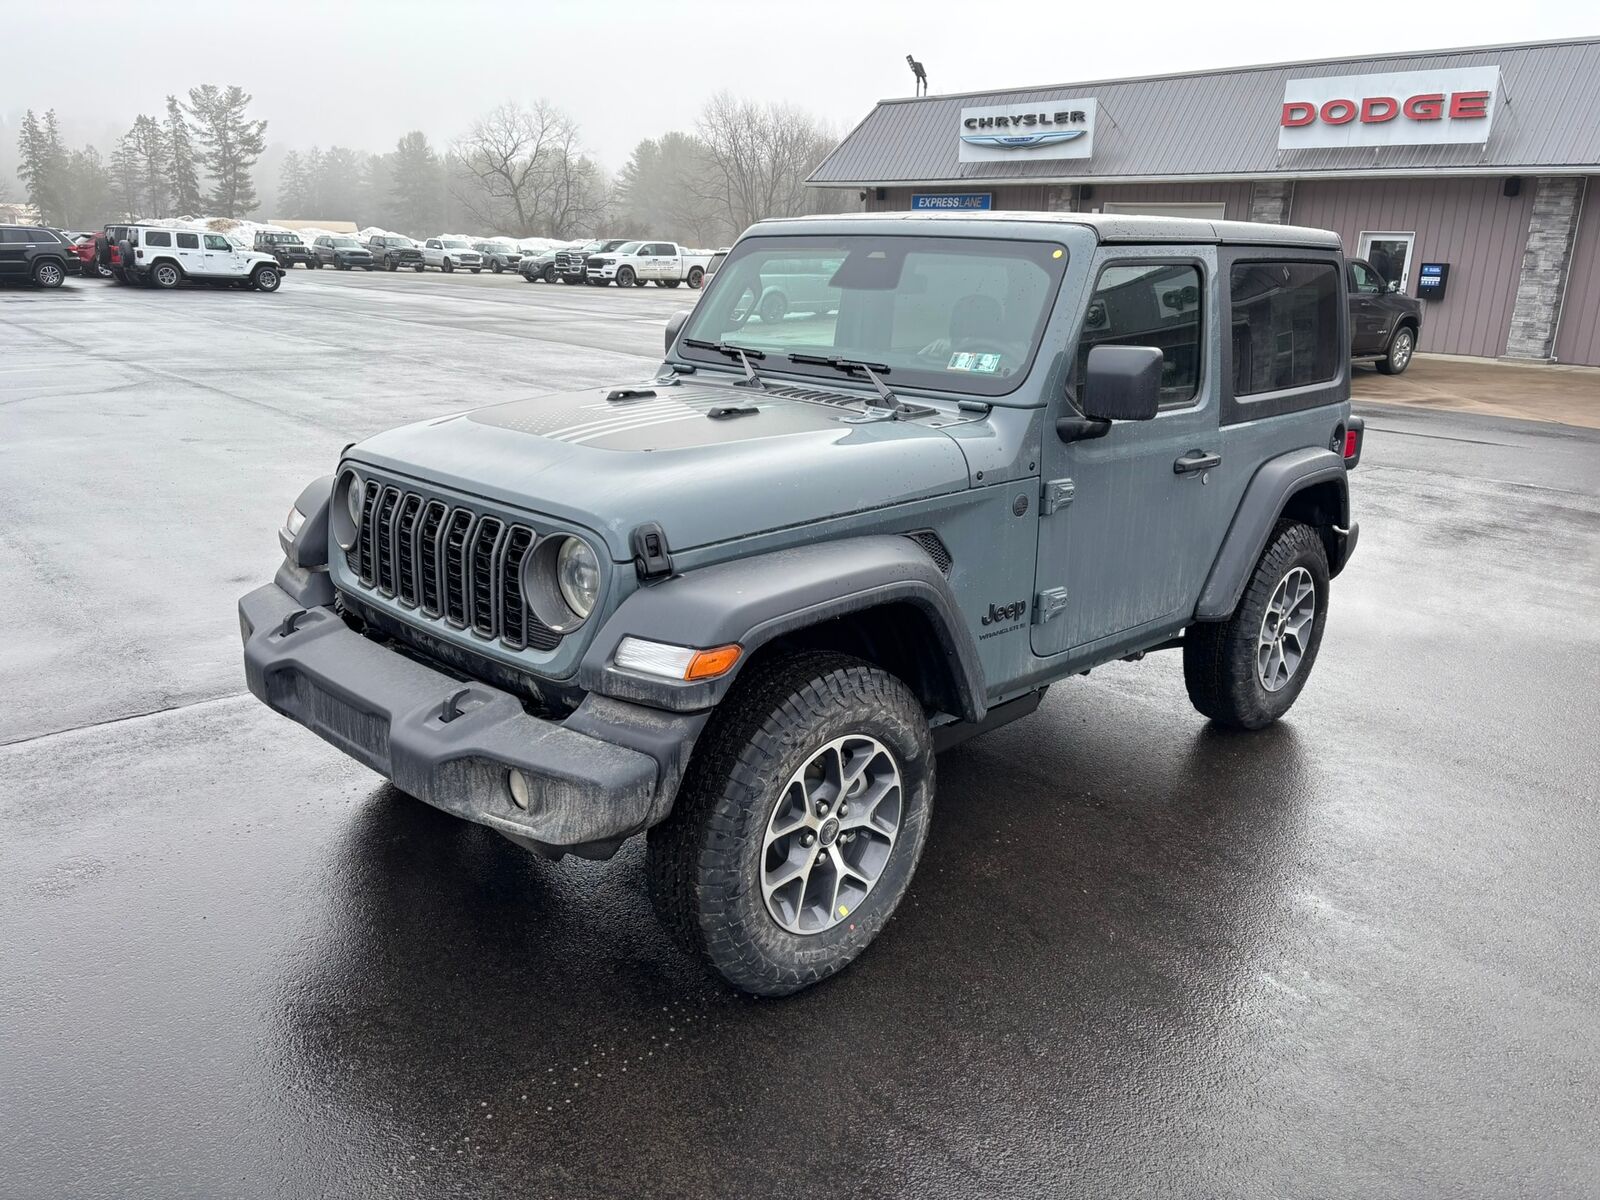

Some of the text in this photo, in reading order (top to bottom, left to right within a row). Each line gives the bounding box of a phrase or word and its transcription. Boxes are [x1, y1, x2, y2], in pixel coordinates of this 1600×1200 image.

[964, 110, 1086, 129] CHRYSLER
[1280, 90, 1491, 127] DODGE
[981, 599, 1026, 626] Jeep
[979, 625, 1019, 641] WRANGLER
